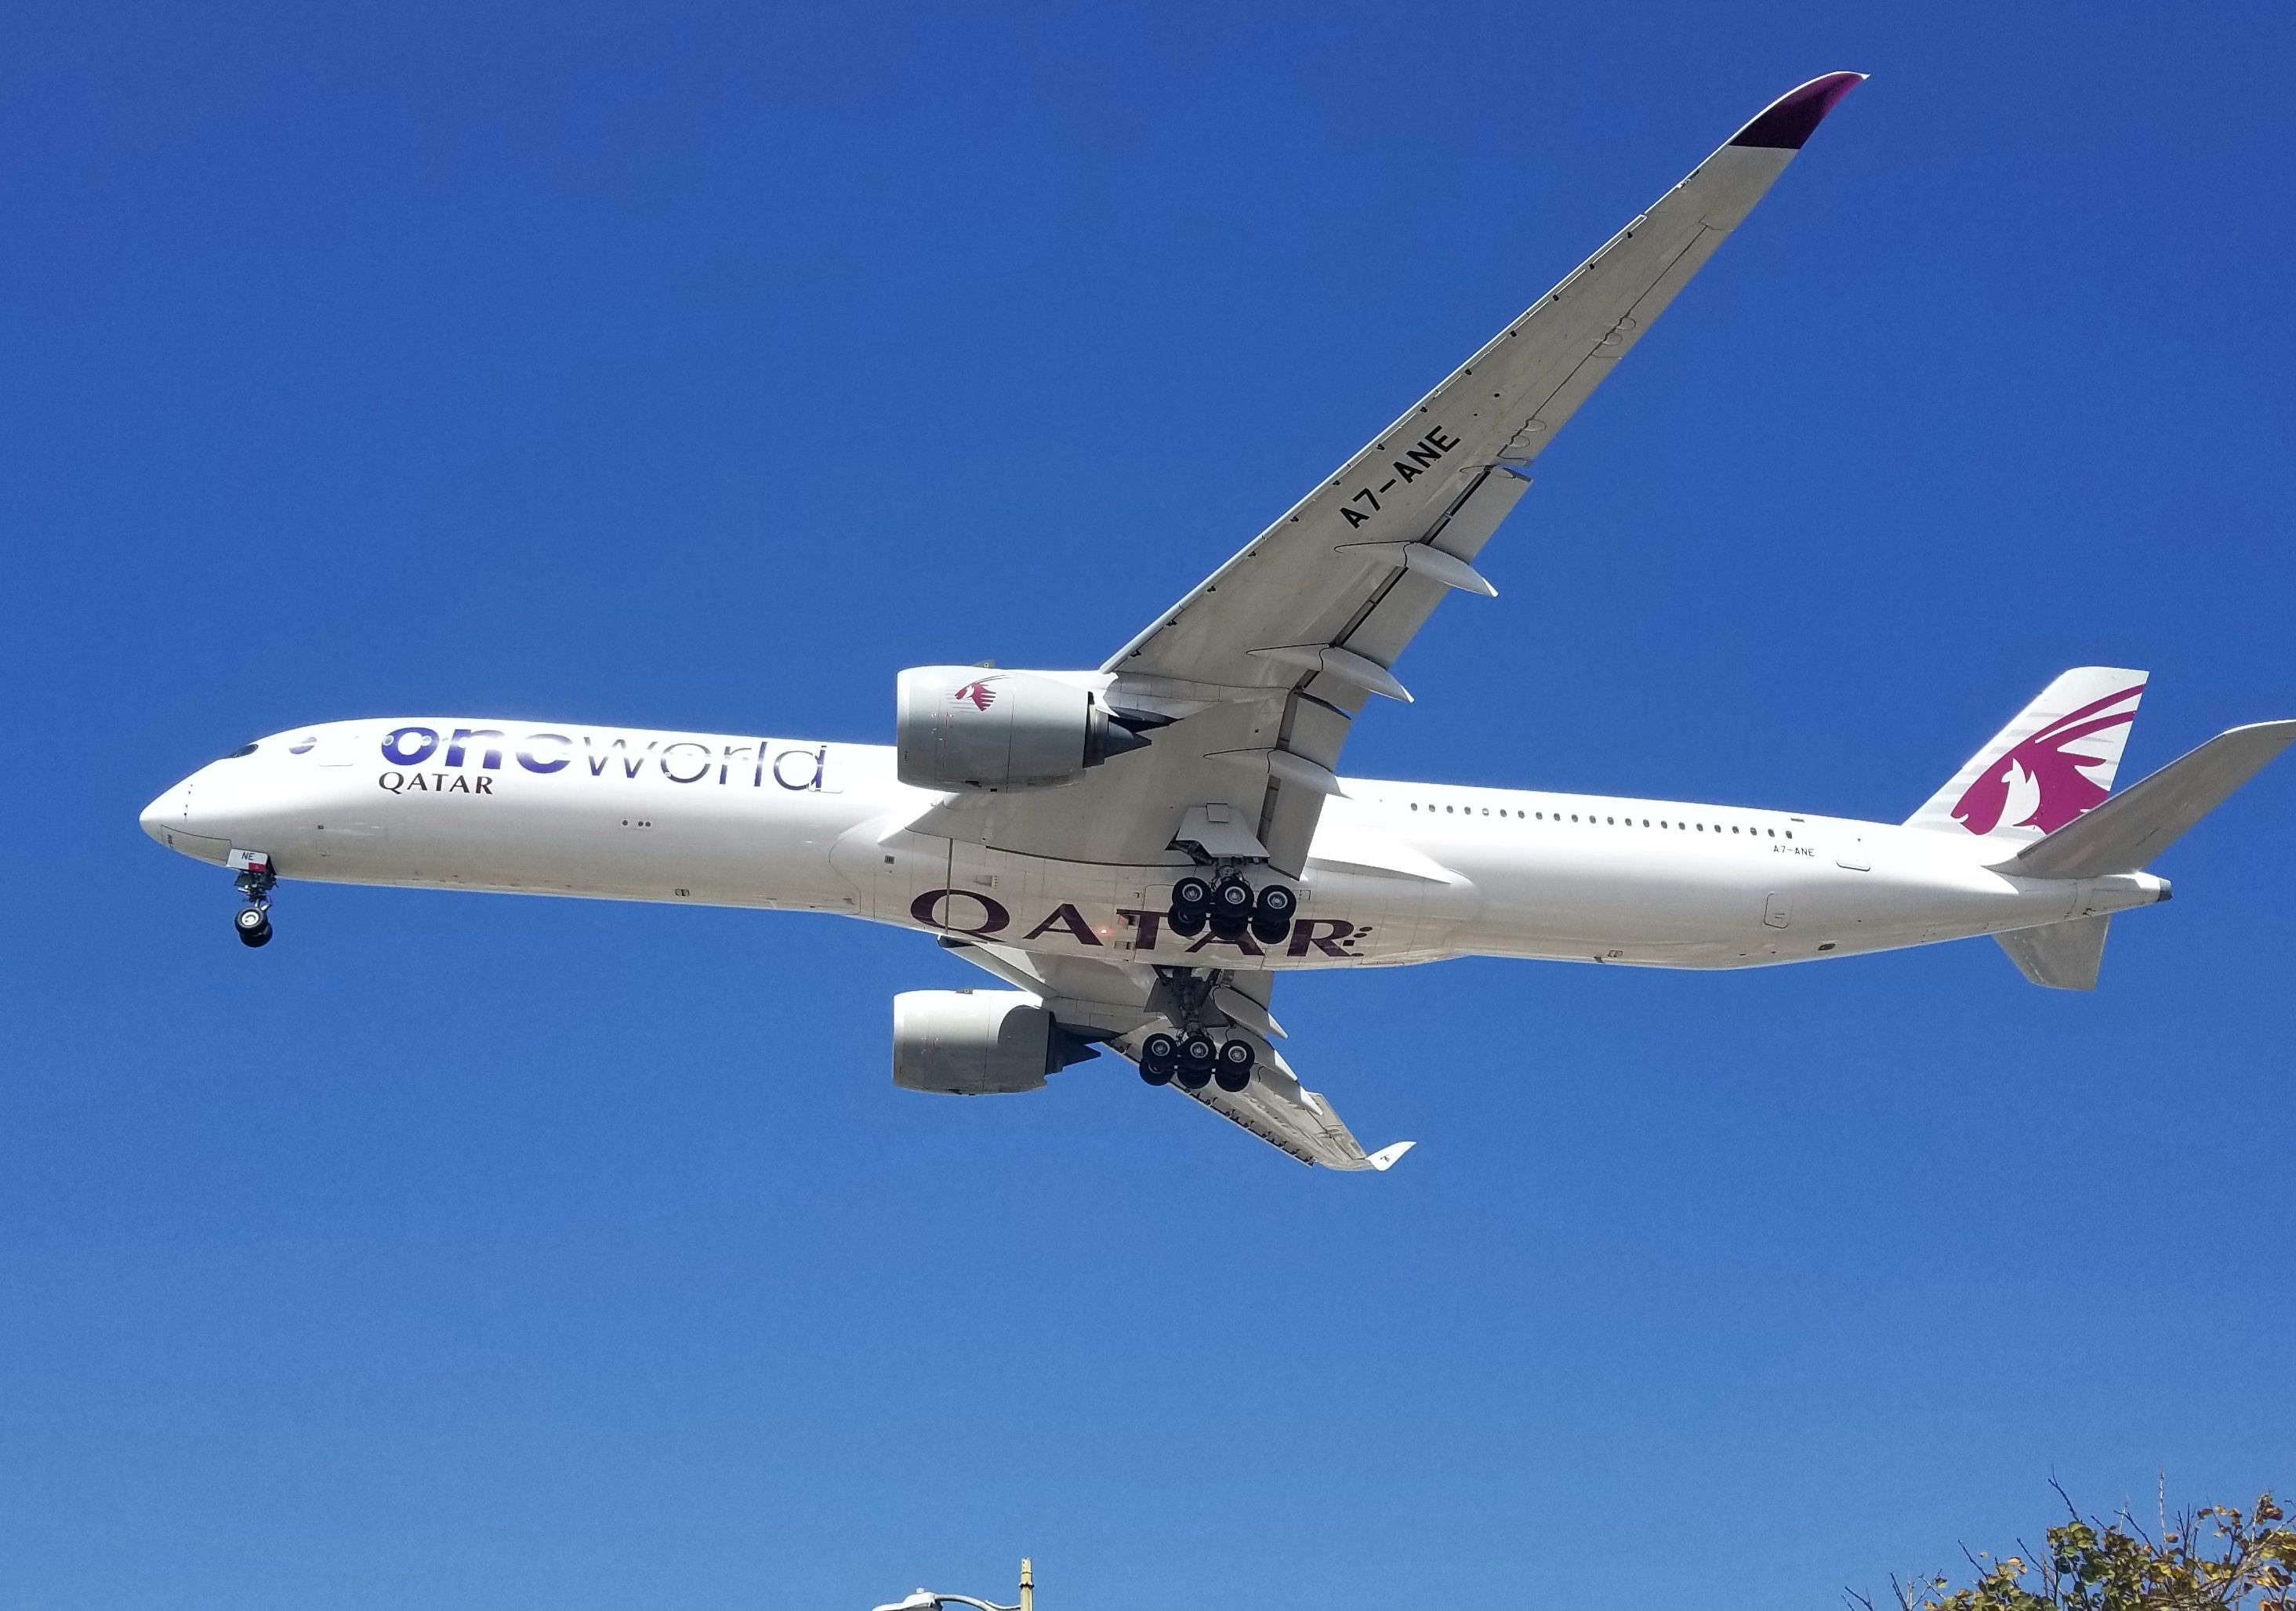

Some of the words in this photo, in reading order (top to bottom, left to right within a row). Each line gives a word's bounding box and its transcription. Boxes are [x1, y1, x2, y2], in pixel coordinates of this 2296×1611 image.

[1340, 425, 1461, 529] A7-ANE
[381, 727, 828, 791] oneworld
[379, 771, 493, 795] QATAR
[241, 851, 255, 861] NE
[1773, 845, 1815, 857] A7-ANE
[910, 889, 1353, 957] QATAR
